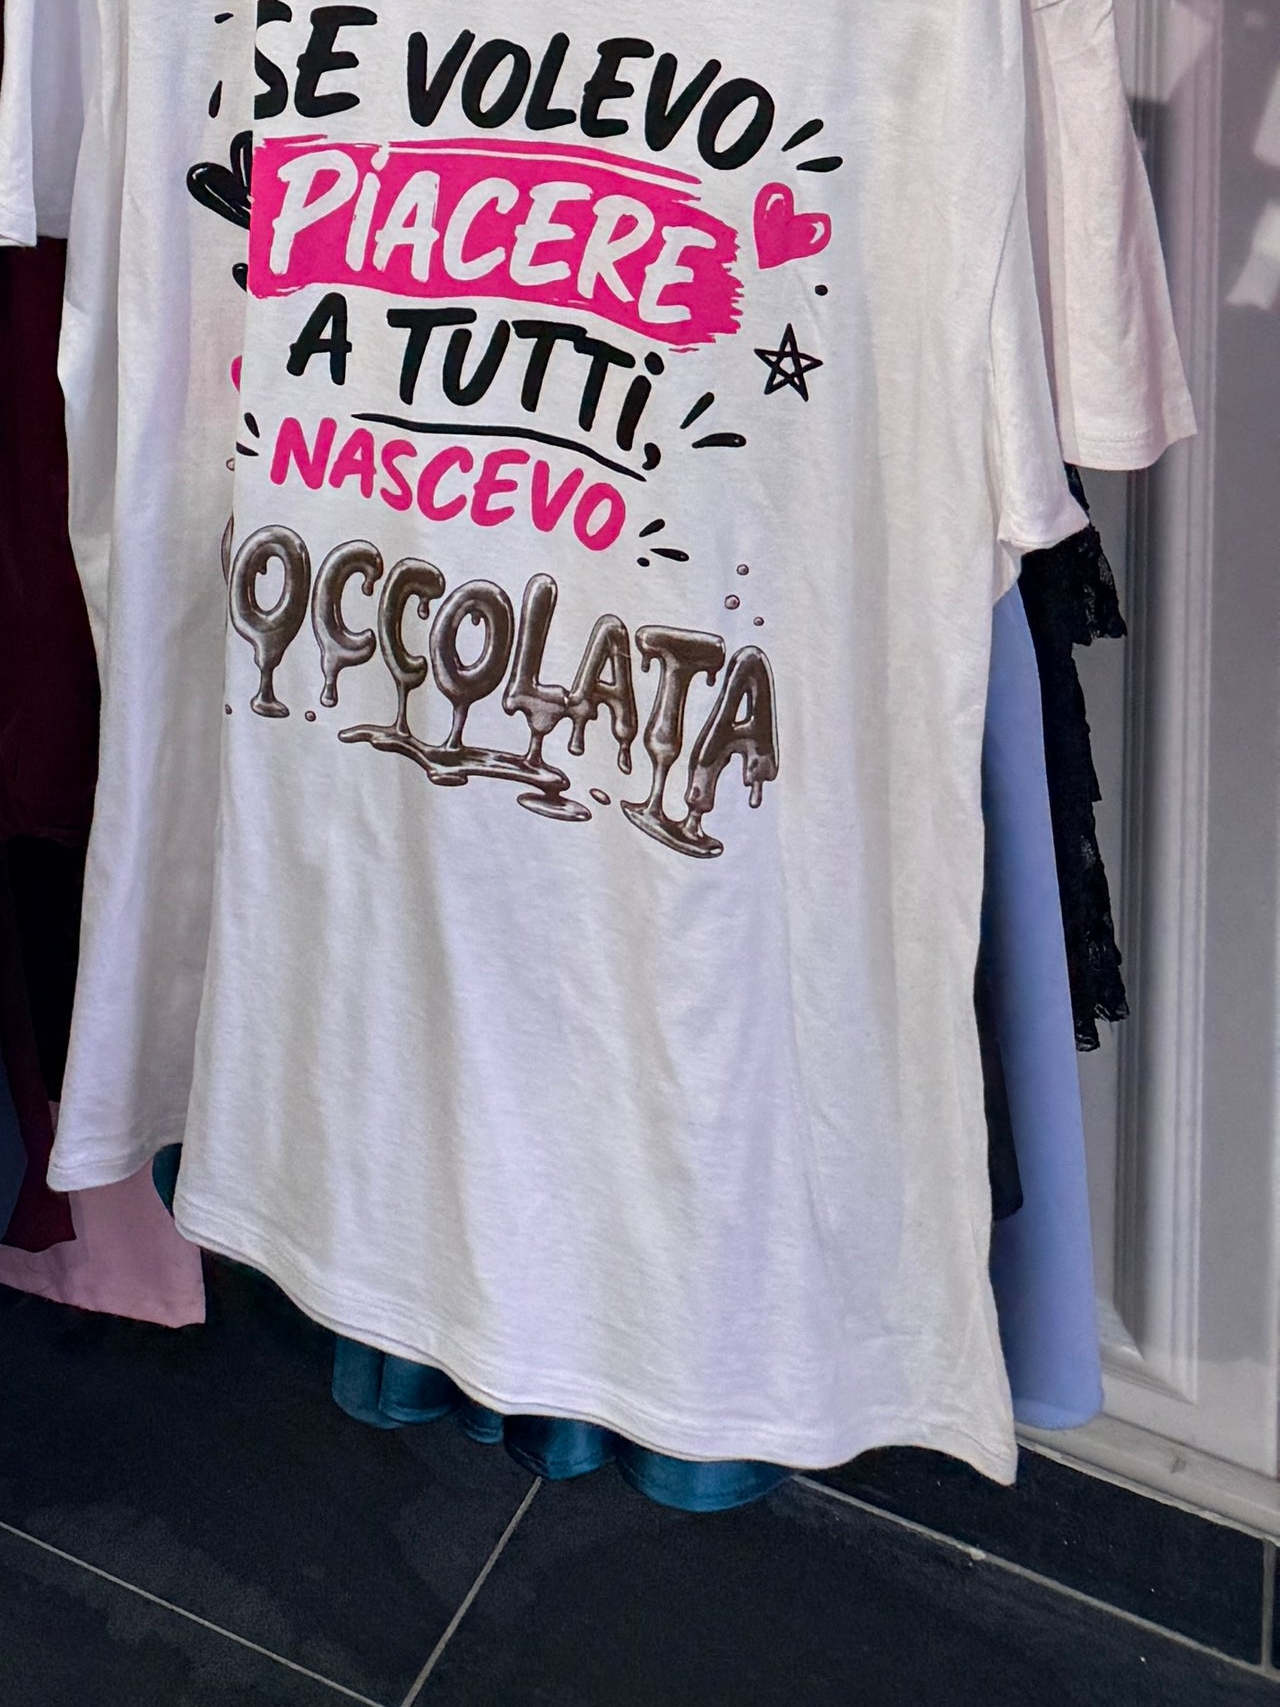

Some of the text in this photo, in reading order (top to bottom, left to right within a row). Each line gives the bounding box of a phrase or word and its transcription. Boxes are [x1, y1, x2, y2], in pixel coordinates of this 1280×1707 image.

[407, 30, 775, 171] VOLEVO
[286, 292, 352, 386] A
[270, 417, 627, 552] NASCEVO
[223, 524, 781, 859] OCCOLATA
